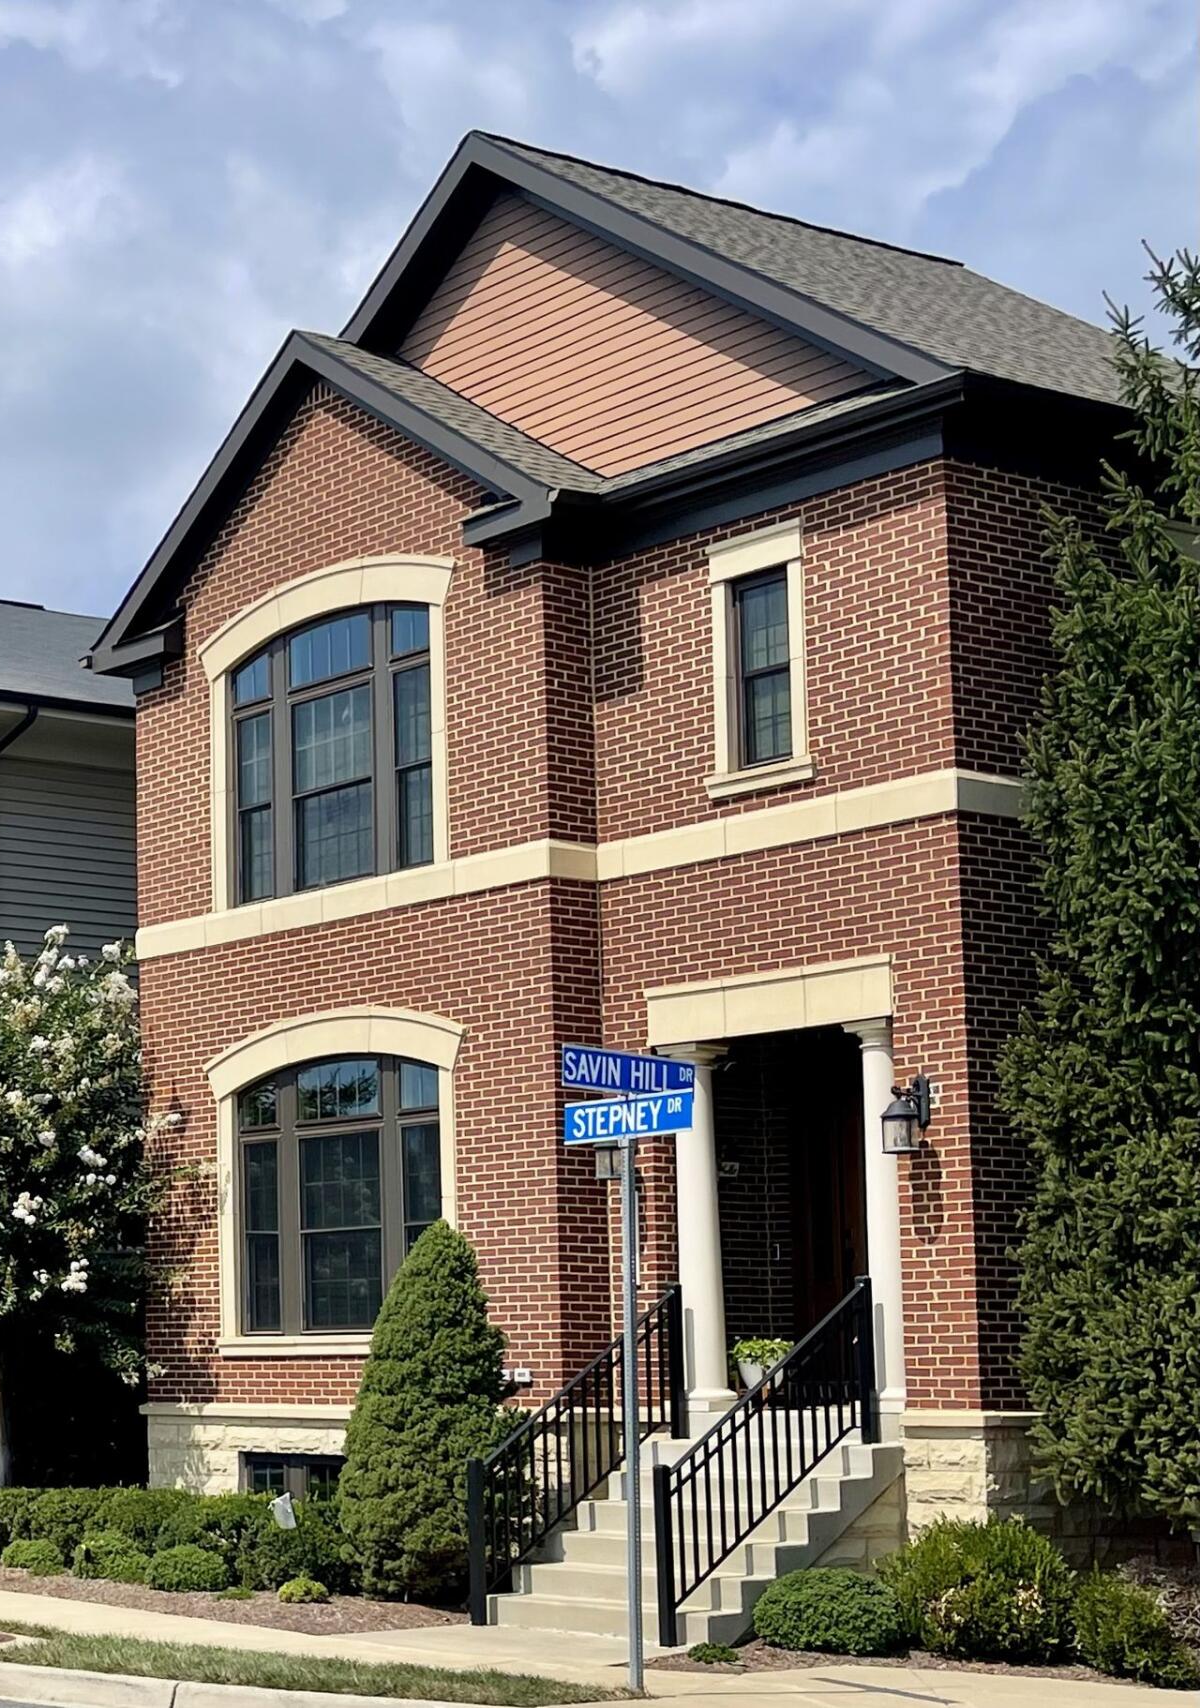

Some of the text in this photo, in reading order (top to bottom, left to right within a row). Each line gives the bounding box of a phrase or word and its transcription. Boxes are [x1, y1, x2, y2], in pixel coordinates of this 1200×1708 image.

[565, 1052, 693, 1091] SAVIN HILL DR
[573, 1097, 682, 1138] STEPNEY DR
